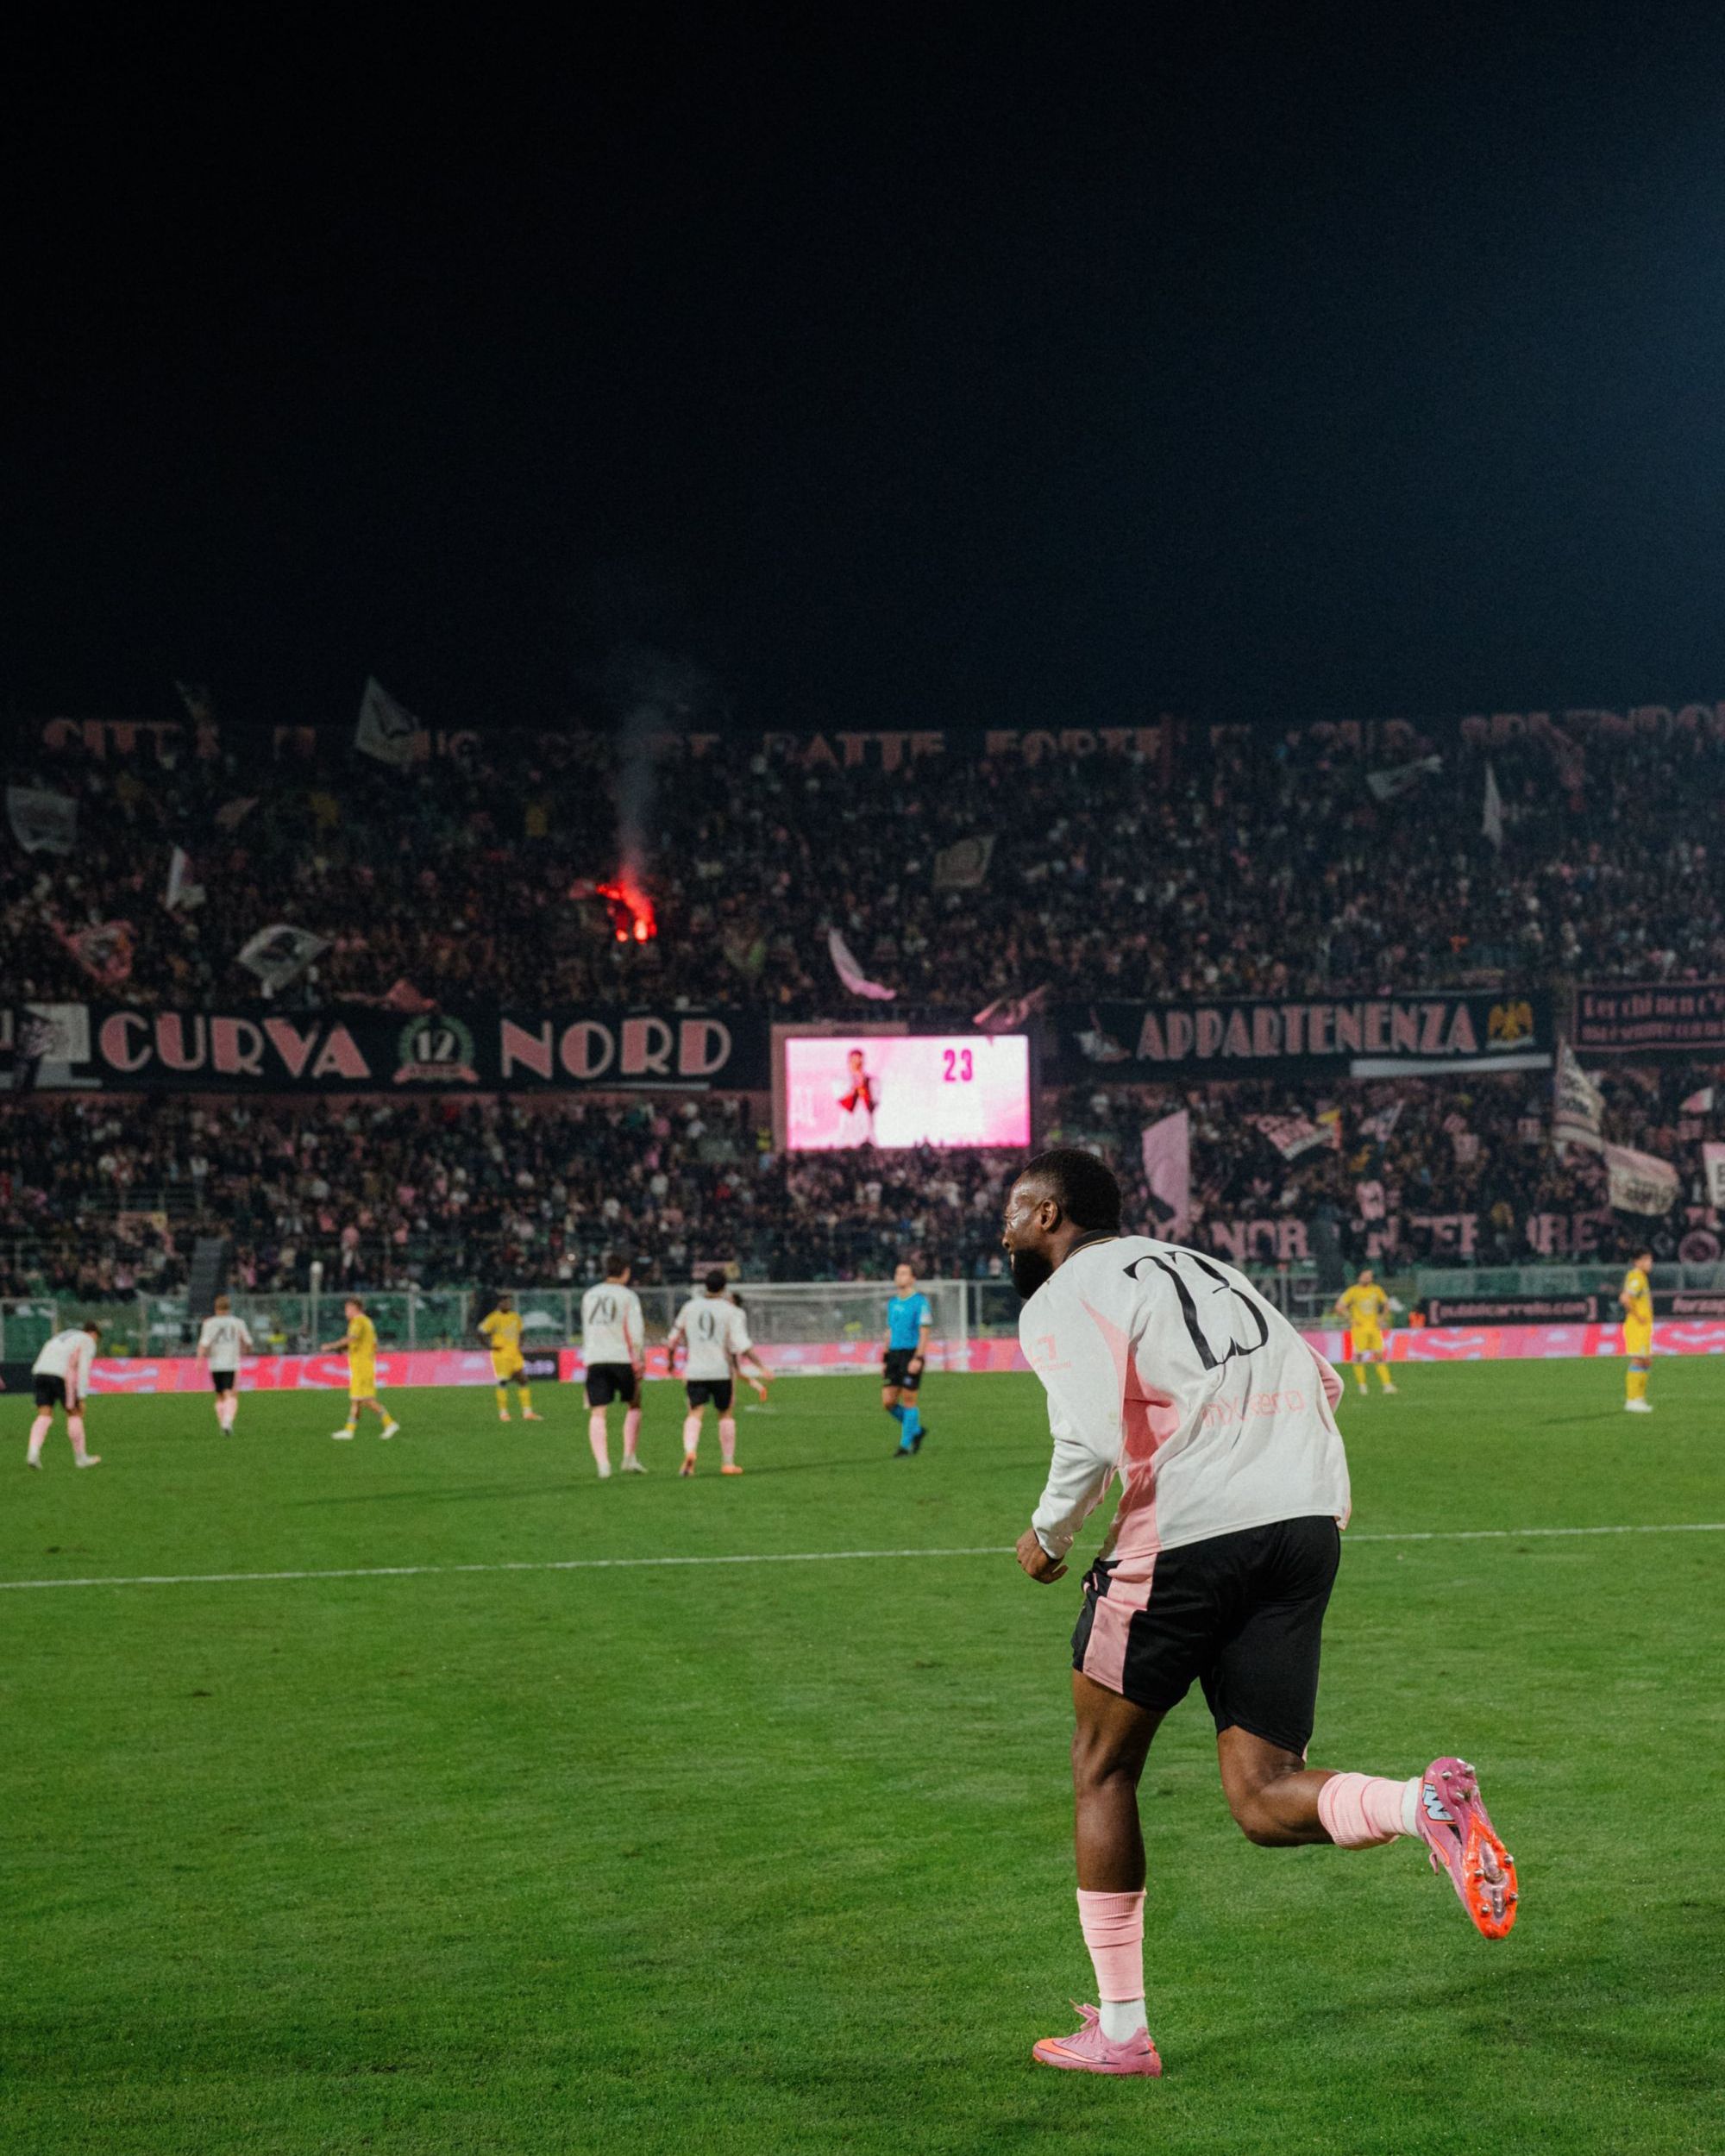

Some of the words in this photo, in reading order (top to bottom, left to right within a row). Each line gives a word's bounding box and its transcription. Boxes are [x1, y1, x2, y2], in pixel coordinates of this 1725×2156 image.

[100, 1012, 371, 1078] CURVA
[500, 1018, 731, 1079] NORD
[417, 1029, 455, 1062] 12
[1135, 1001, 1477, 1062] APPARTENENZA
[944, 1049, 973, 1081] 23
[698, 1309, 715, 1340] 9
[1123, 1250, 1269, 1371] 23
